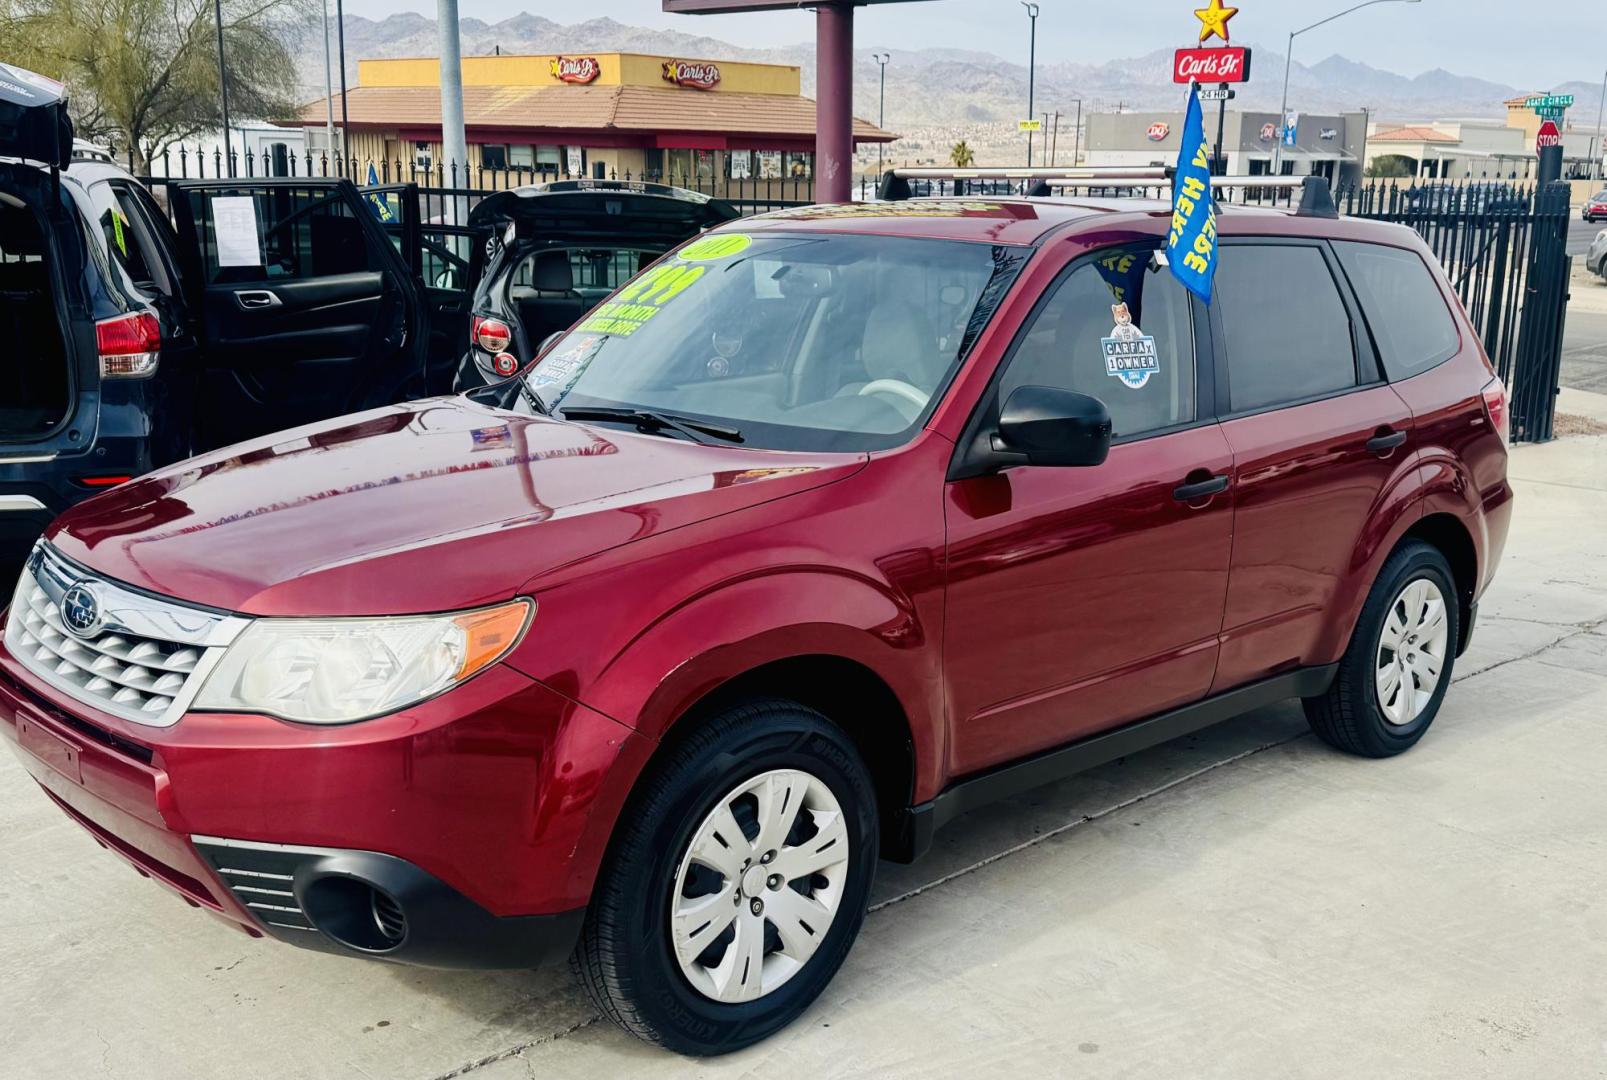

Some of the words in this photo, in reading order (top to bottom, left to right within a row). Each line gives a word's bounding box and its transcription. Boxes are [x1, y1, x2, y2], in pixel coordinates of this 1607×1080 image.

[1178, 55, 1217, 77] Carl's
[1218, 54, 1240, 76] Jr.
[1201, 91, 1211, 99] 24
[1548, 96, 1573, 104] CIRCLE
[1151, 126, 1166, 137] DQ
[1538, 135, 1557, 147] STOP
[1107, 341, 1152, 355] CARFAX
